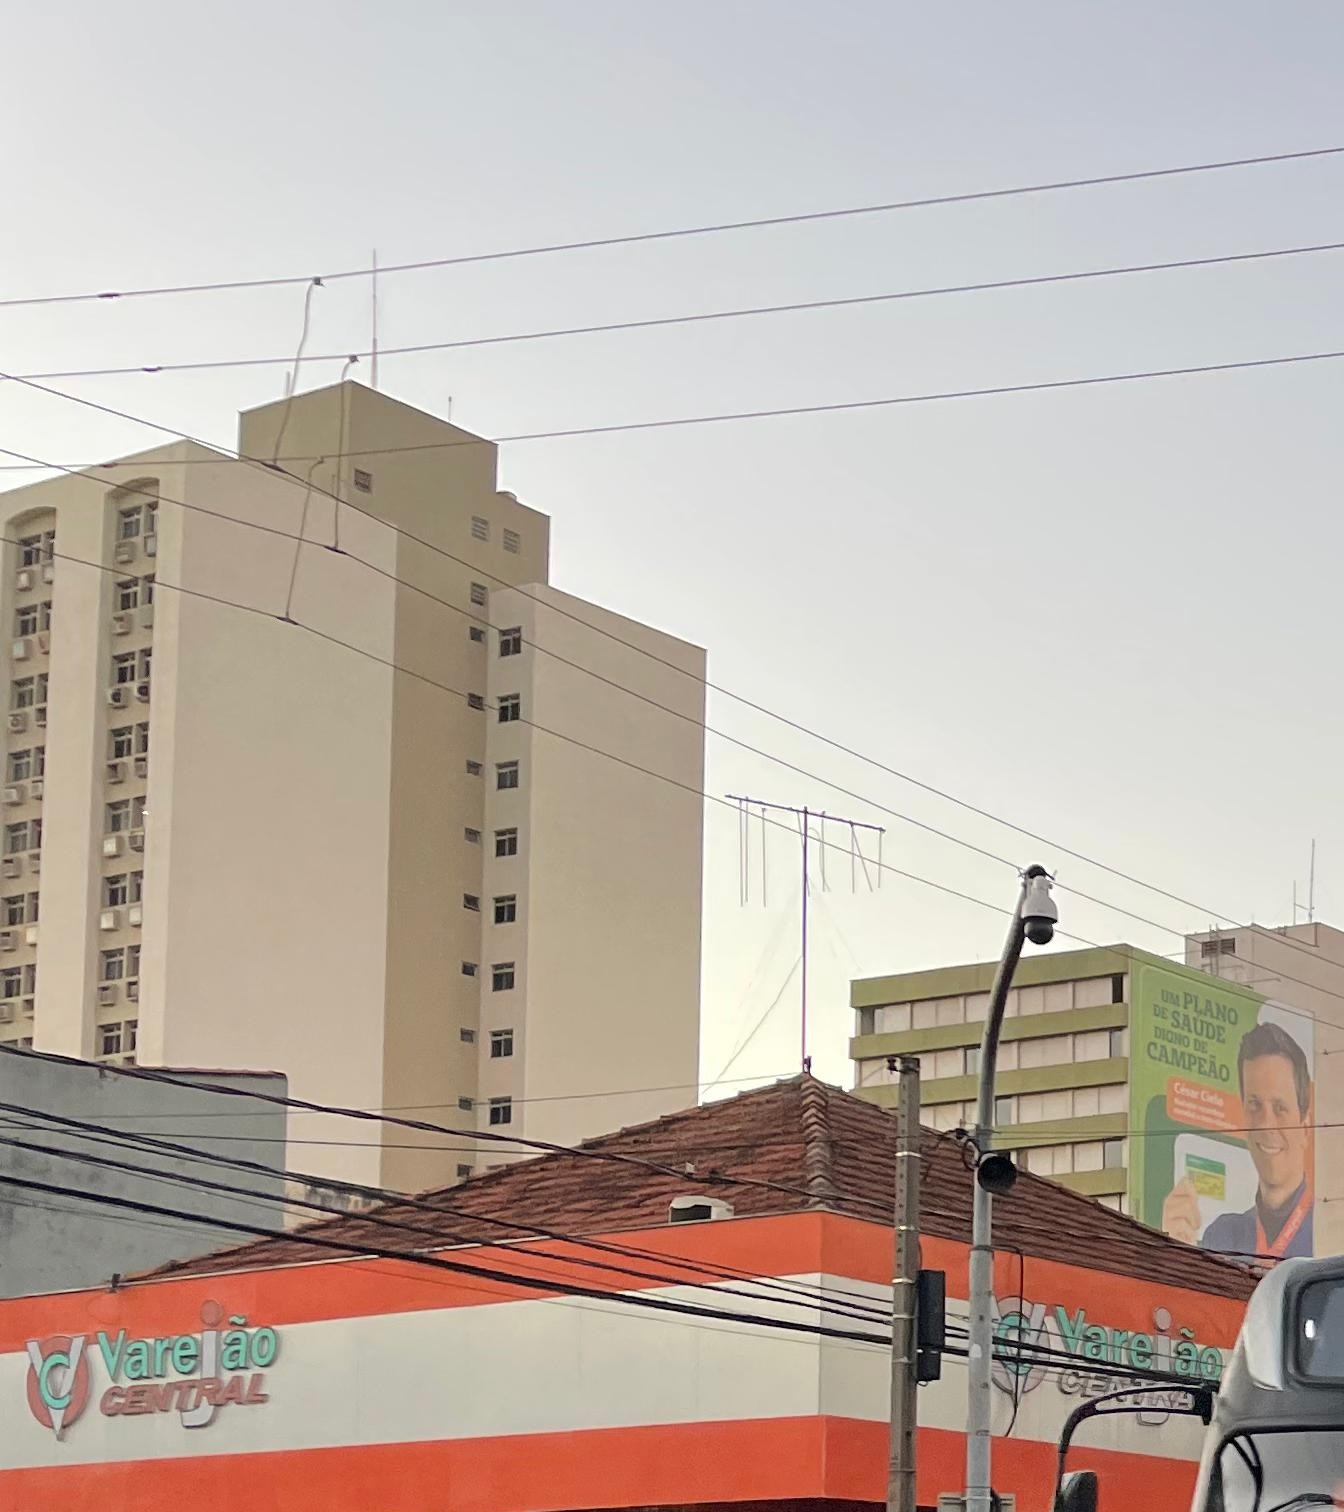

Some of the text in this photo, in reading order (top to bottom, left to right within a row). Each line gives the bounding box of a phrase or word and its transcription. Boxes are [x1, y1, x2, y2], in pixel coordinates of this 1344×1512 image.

[1153, 1004, 1226, 1044] DE SAÚDE
[1161, 989, 1238, 1025] UM PLANO
[1154, 1026, 1208, 1053] DIGNO DE
[1147, 1041, 1230, 1082] CAMPEÃO
[97, 1300, 278, 1428] Varejão
[100, 1374, 269, 1416] CENTRAL
